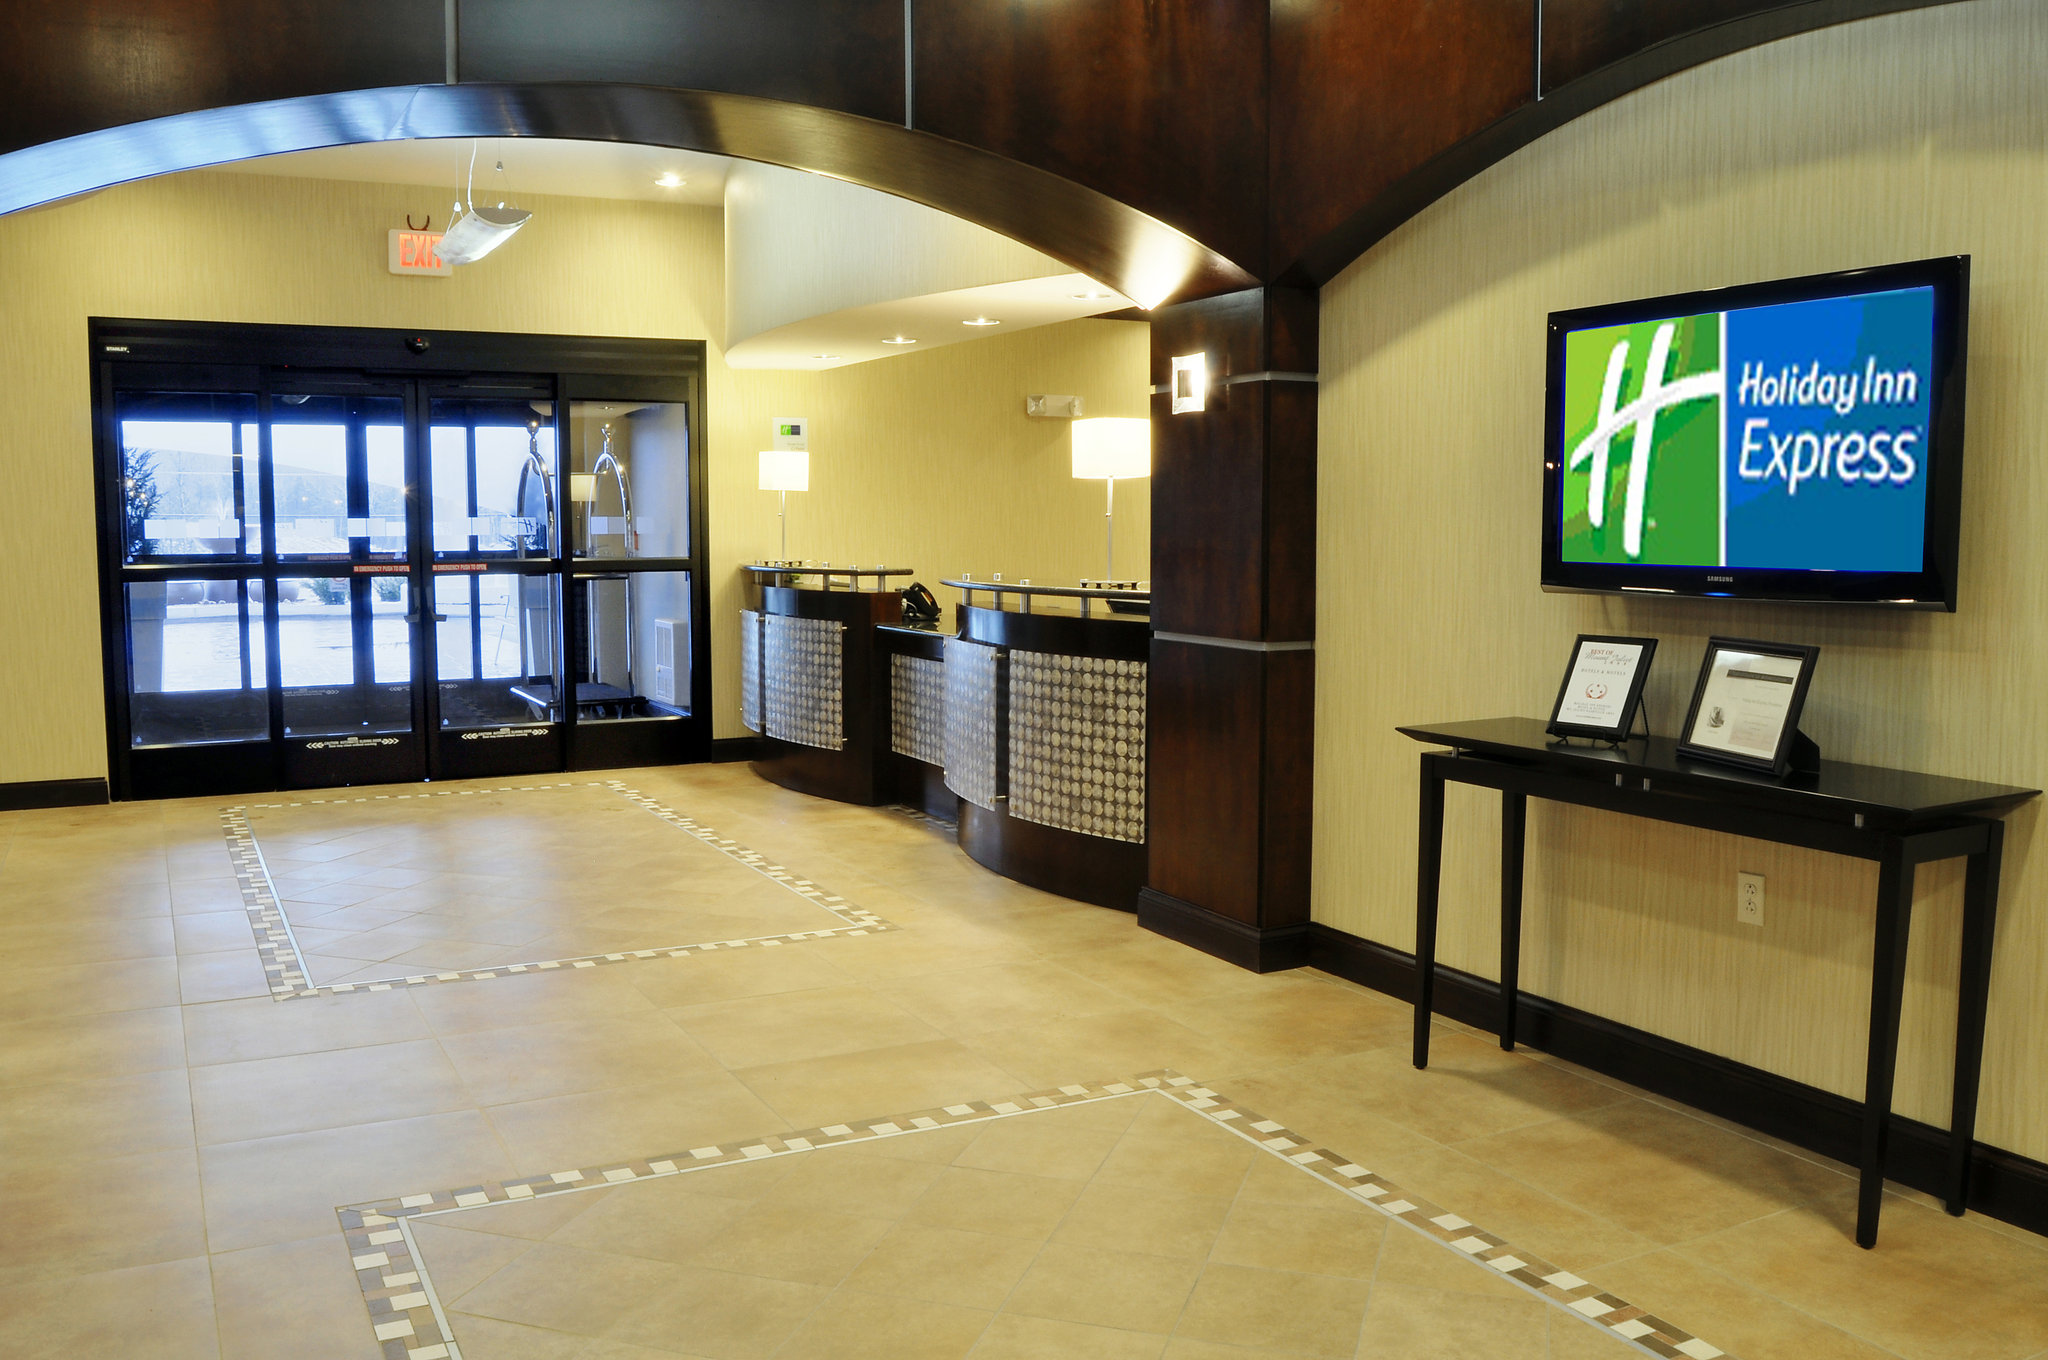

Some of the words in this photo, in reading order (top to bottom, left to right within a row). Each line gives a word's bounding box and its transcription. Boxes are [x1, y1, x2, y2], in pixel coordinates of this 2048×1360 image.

[399, 233, 444, 268] EXIT
[1739, 360, 1858, 415] Holiday
[1863, 355, 1917, 403] Inn
[1739, 418, 1917, 495] Express
